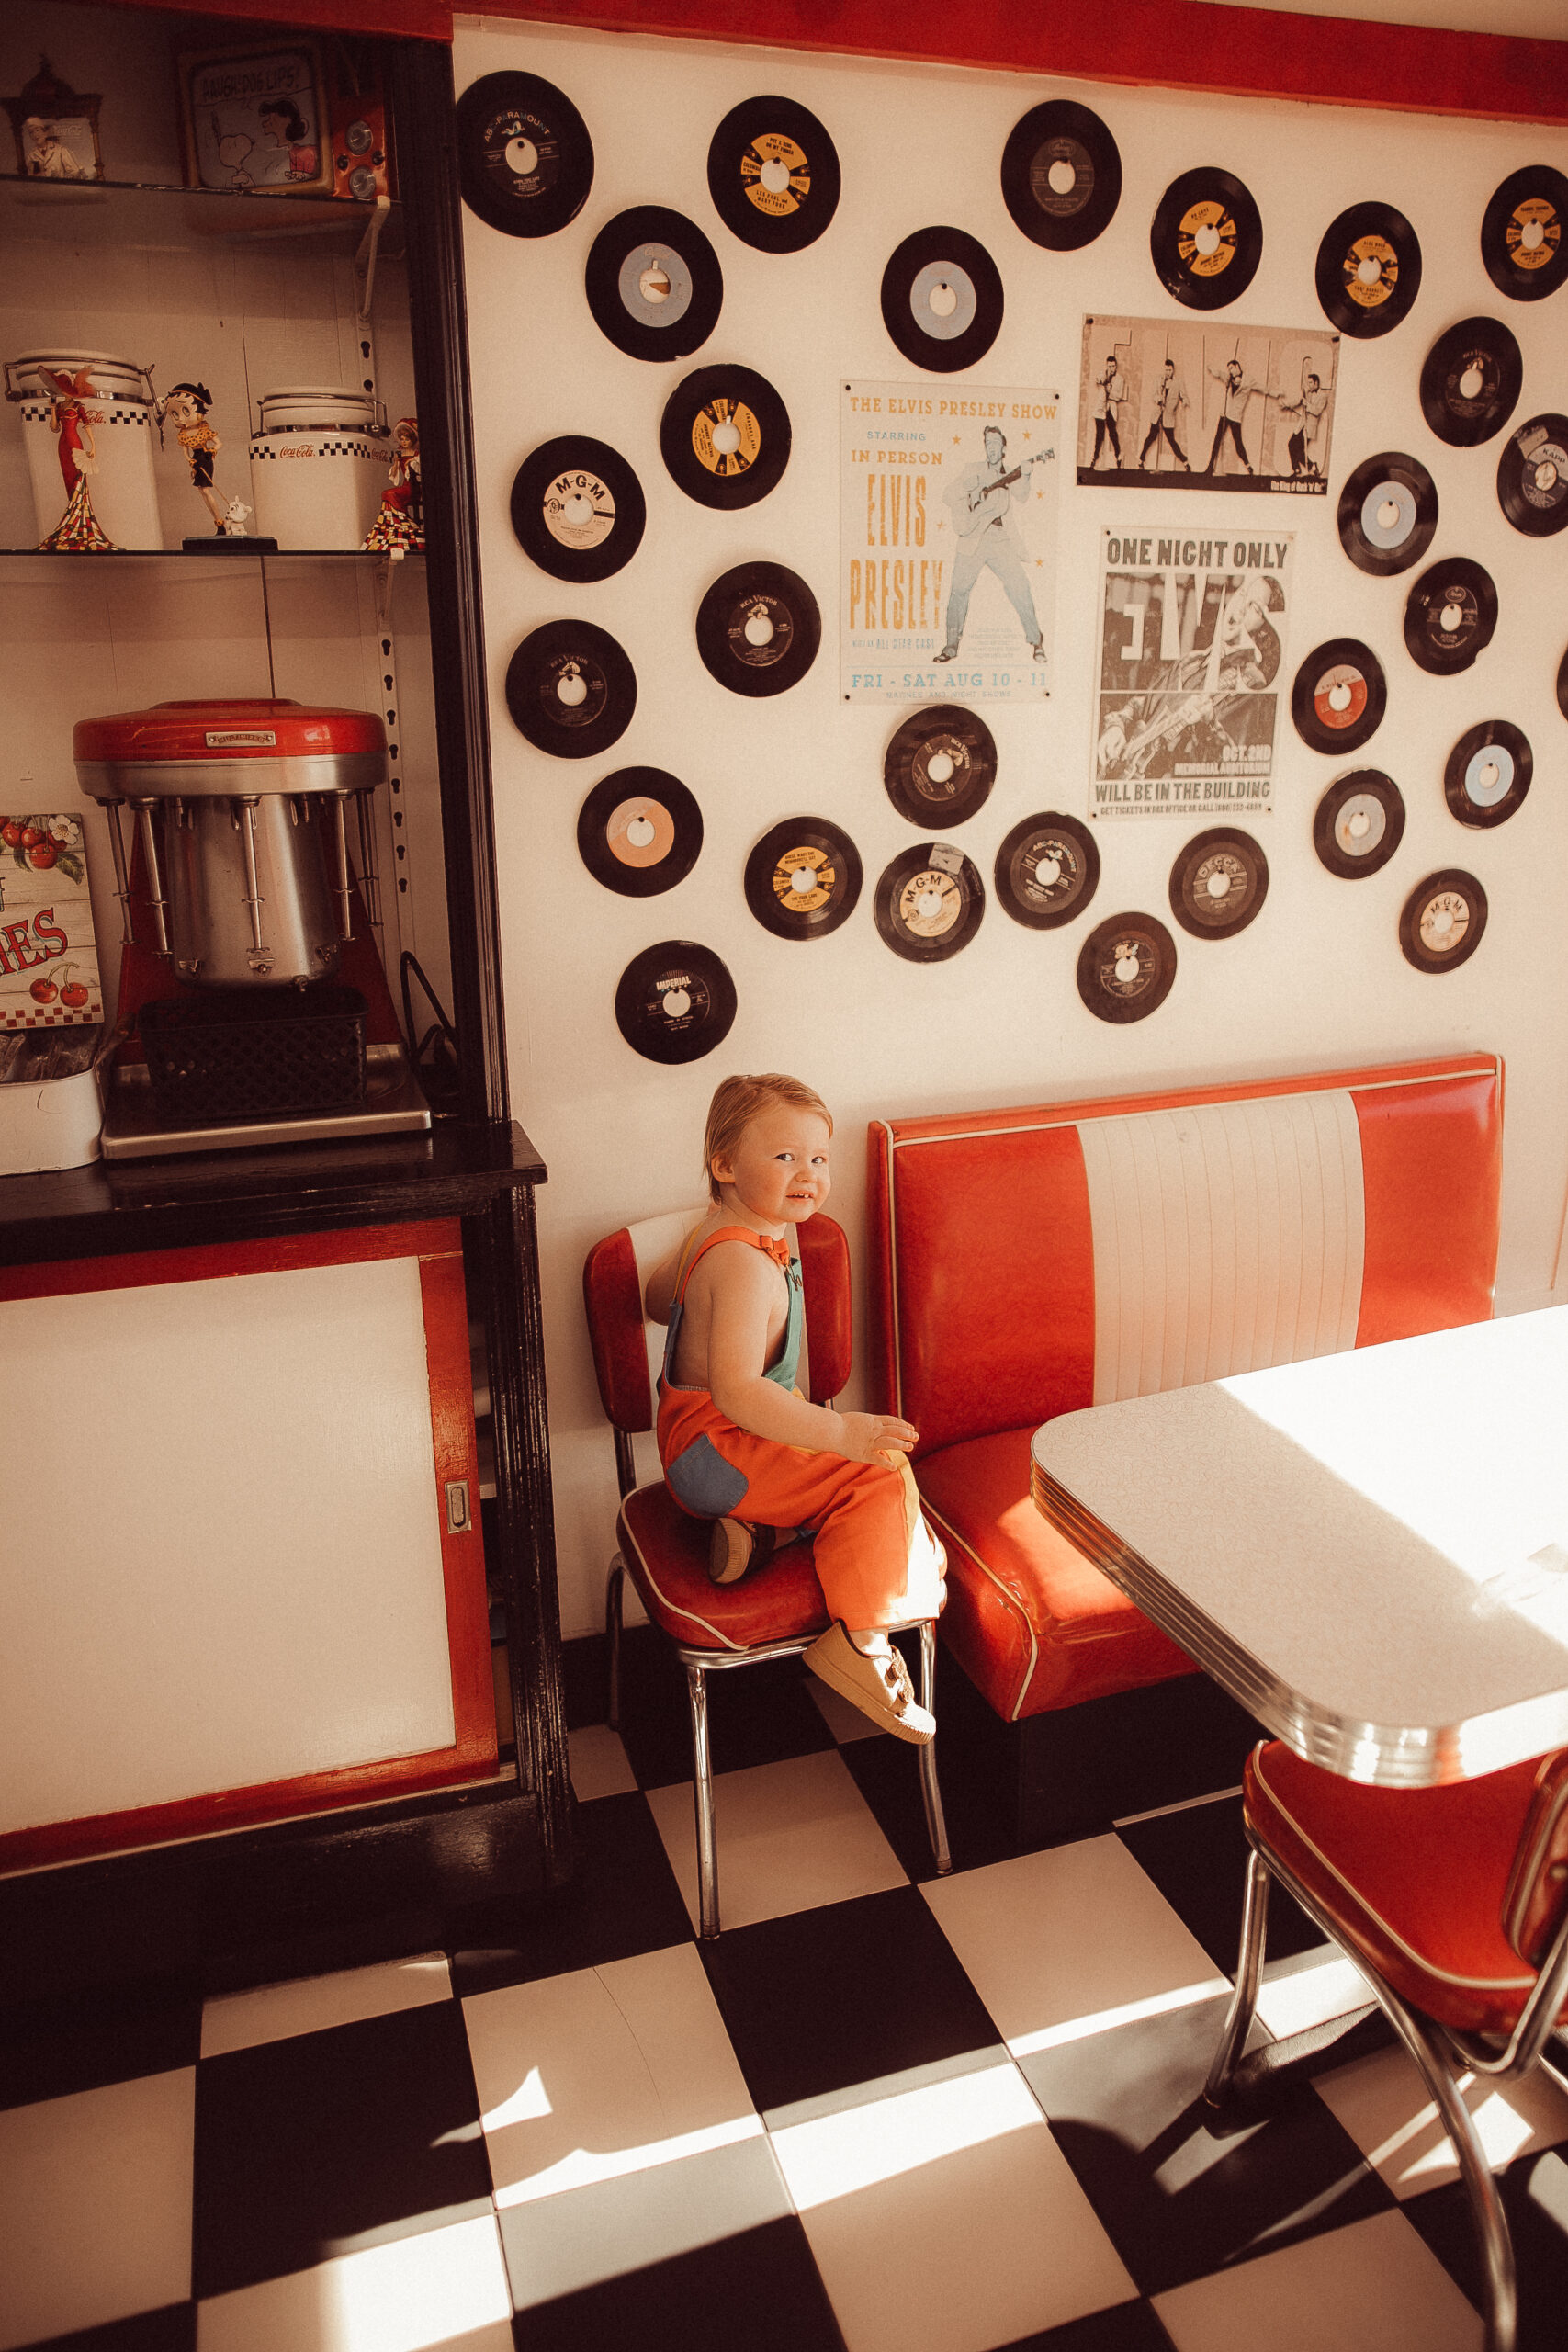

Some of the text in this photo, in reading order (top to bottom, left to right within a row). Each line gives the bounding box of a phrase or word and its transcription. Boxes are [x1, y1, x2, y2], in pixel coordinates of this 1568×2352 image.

[484, 111, 551, 142] ABC-PARAMOUNT
[850, 397, 1058, 420] THE ELVIS PRESLEY SHOW
[867, 430, 926, 441] STARRING
[852, 449, 942, 465] IN PERSON
[1542, 447, 1566, 464] KAPP
[555, 474, 606, 501] M-G-M
[867, 473, 926, 547] ELVIS
[1106, 537, 1288, 569] ONE NIGHT ONLY
[850, 559, 943, 630] PRESLEY
[852, 674, 883, 688] FRI
[903, 673, 936, 687] SAT
[944, 673, 983, 687] AUG
[992, 673, 1010, 687] 10
[1031, 673, 1046, 686] 11
[886, 691, 922, 699] MATINEE
[952, 690, 977, 698] NIGHT
[982, 690, 1011, 698] SHOWS
[1096, 781, 1270, 802] WILL BE IN THE BUILDING
[1100, 807, 1113, 815] GET
[1115, 805, 1143, 815] TICKETS
[1198, 803, 1213, 812] CALL
[905, 874, 942, 903] M-G-M
[656, 975, 692, 991] IMPERIAL
